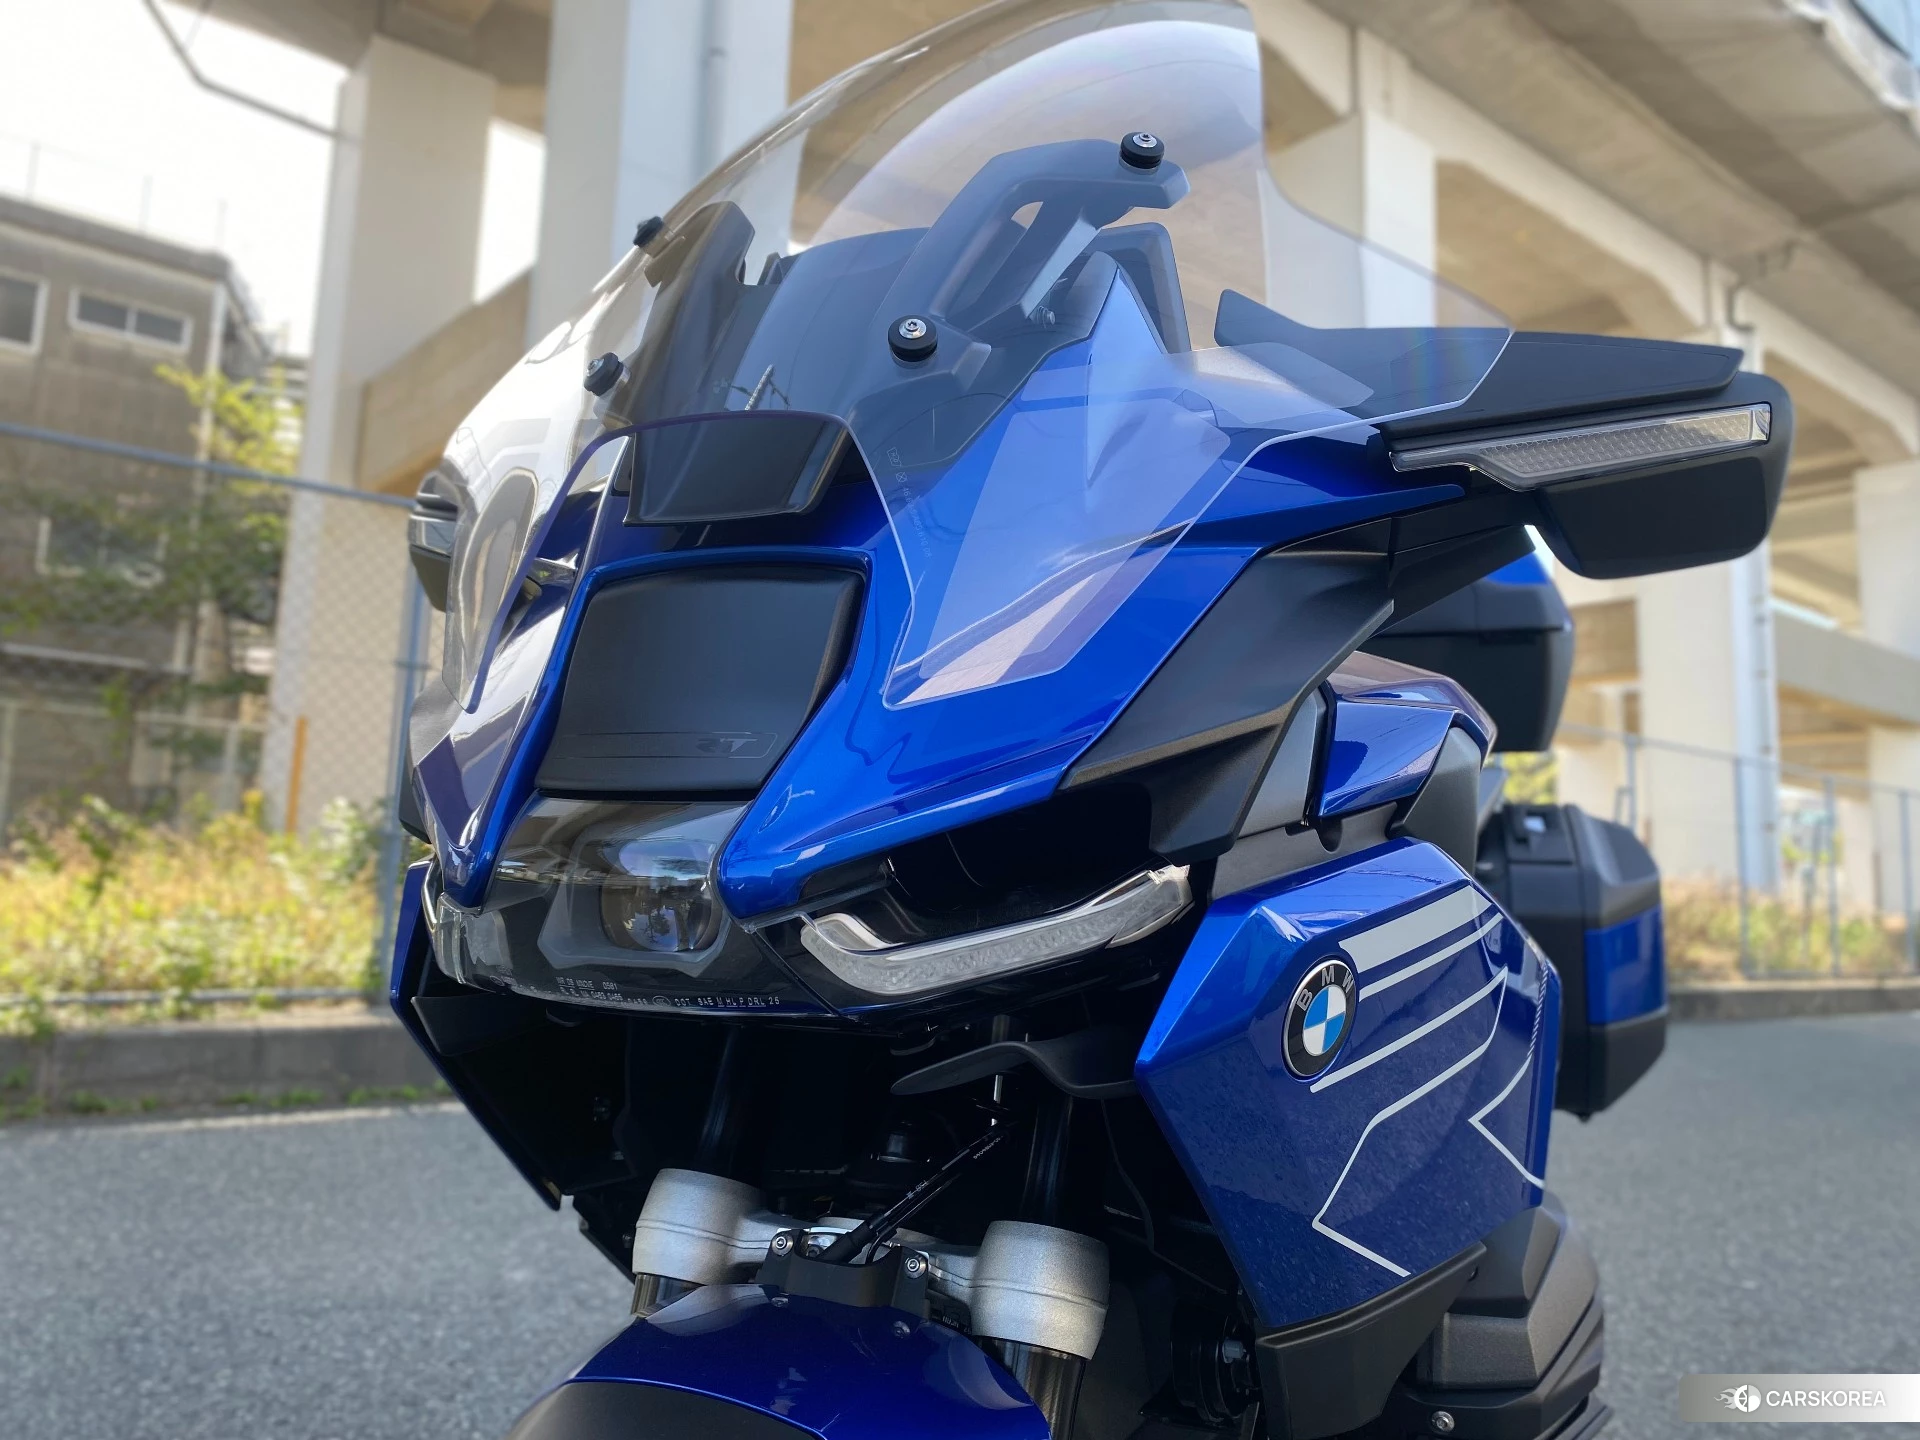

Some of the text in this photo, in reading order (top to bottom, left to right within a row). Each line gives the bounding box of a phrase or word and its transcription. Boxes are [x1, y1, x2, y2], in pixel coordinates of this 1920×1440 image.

[674, 998, 691, 1006] DOT
[697, 997, 714, 1006] SAE
[747, 997, 766, 1006] DRL
[768, 996, 780, 1005] 25
[1296, 965, 1355, 1011] BMW
